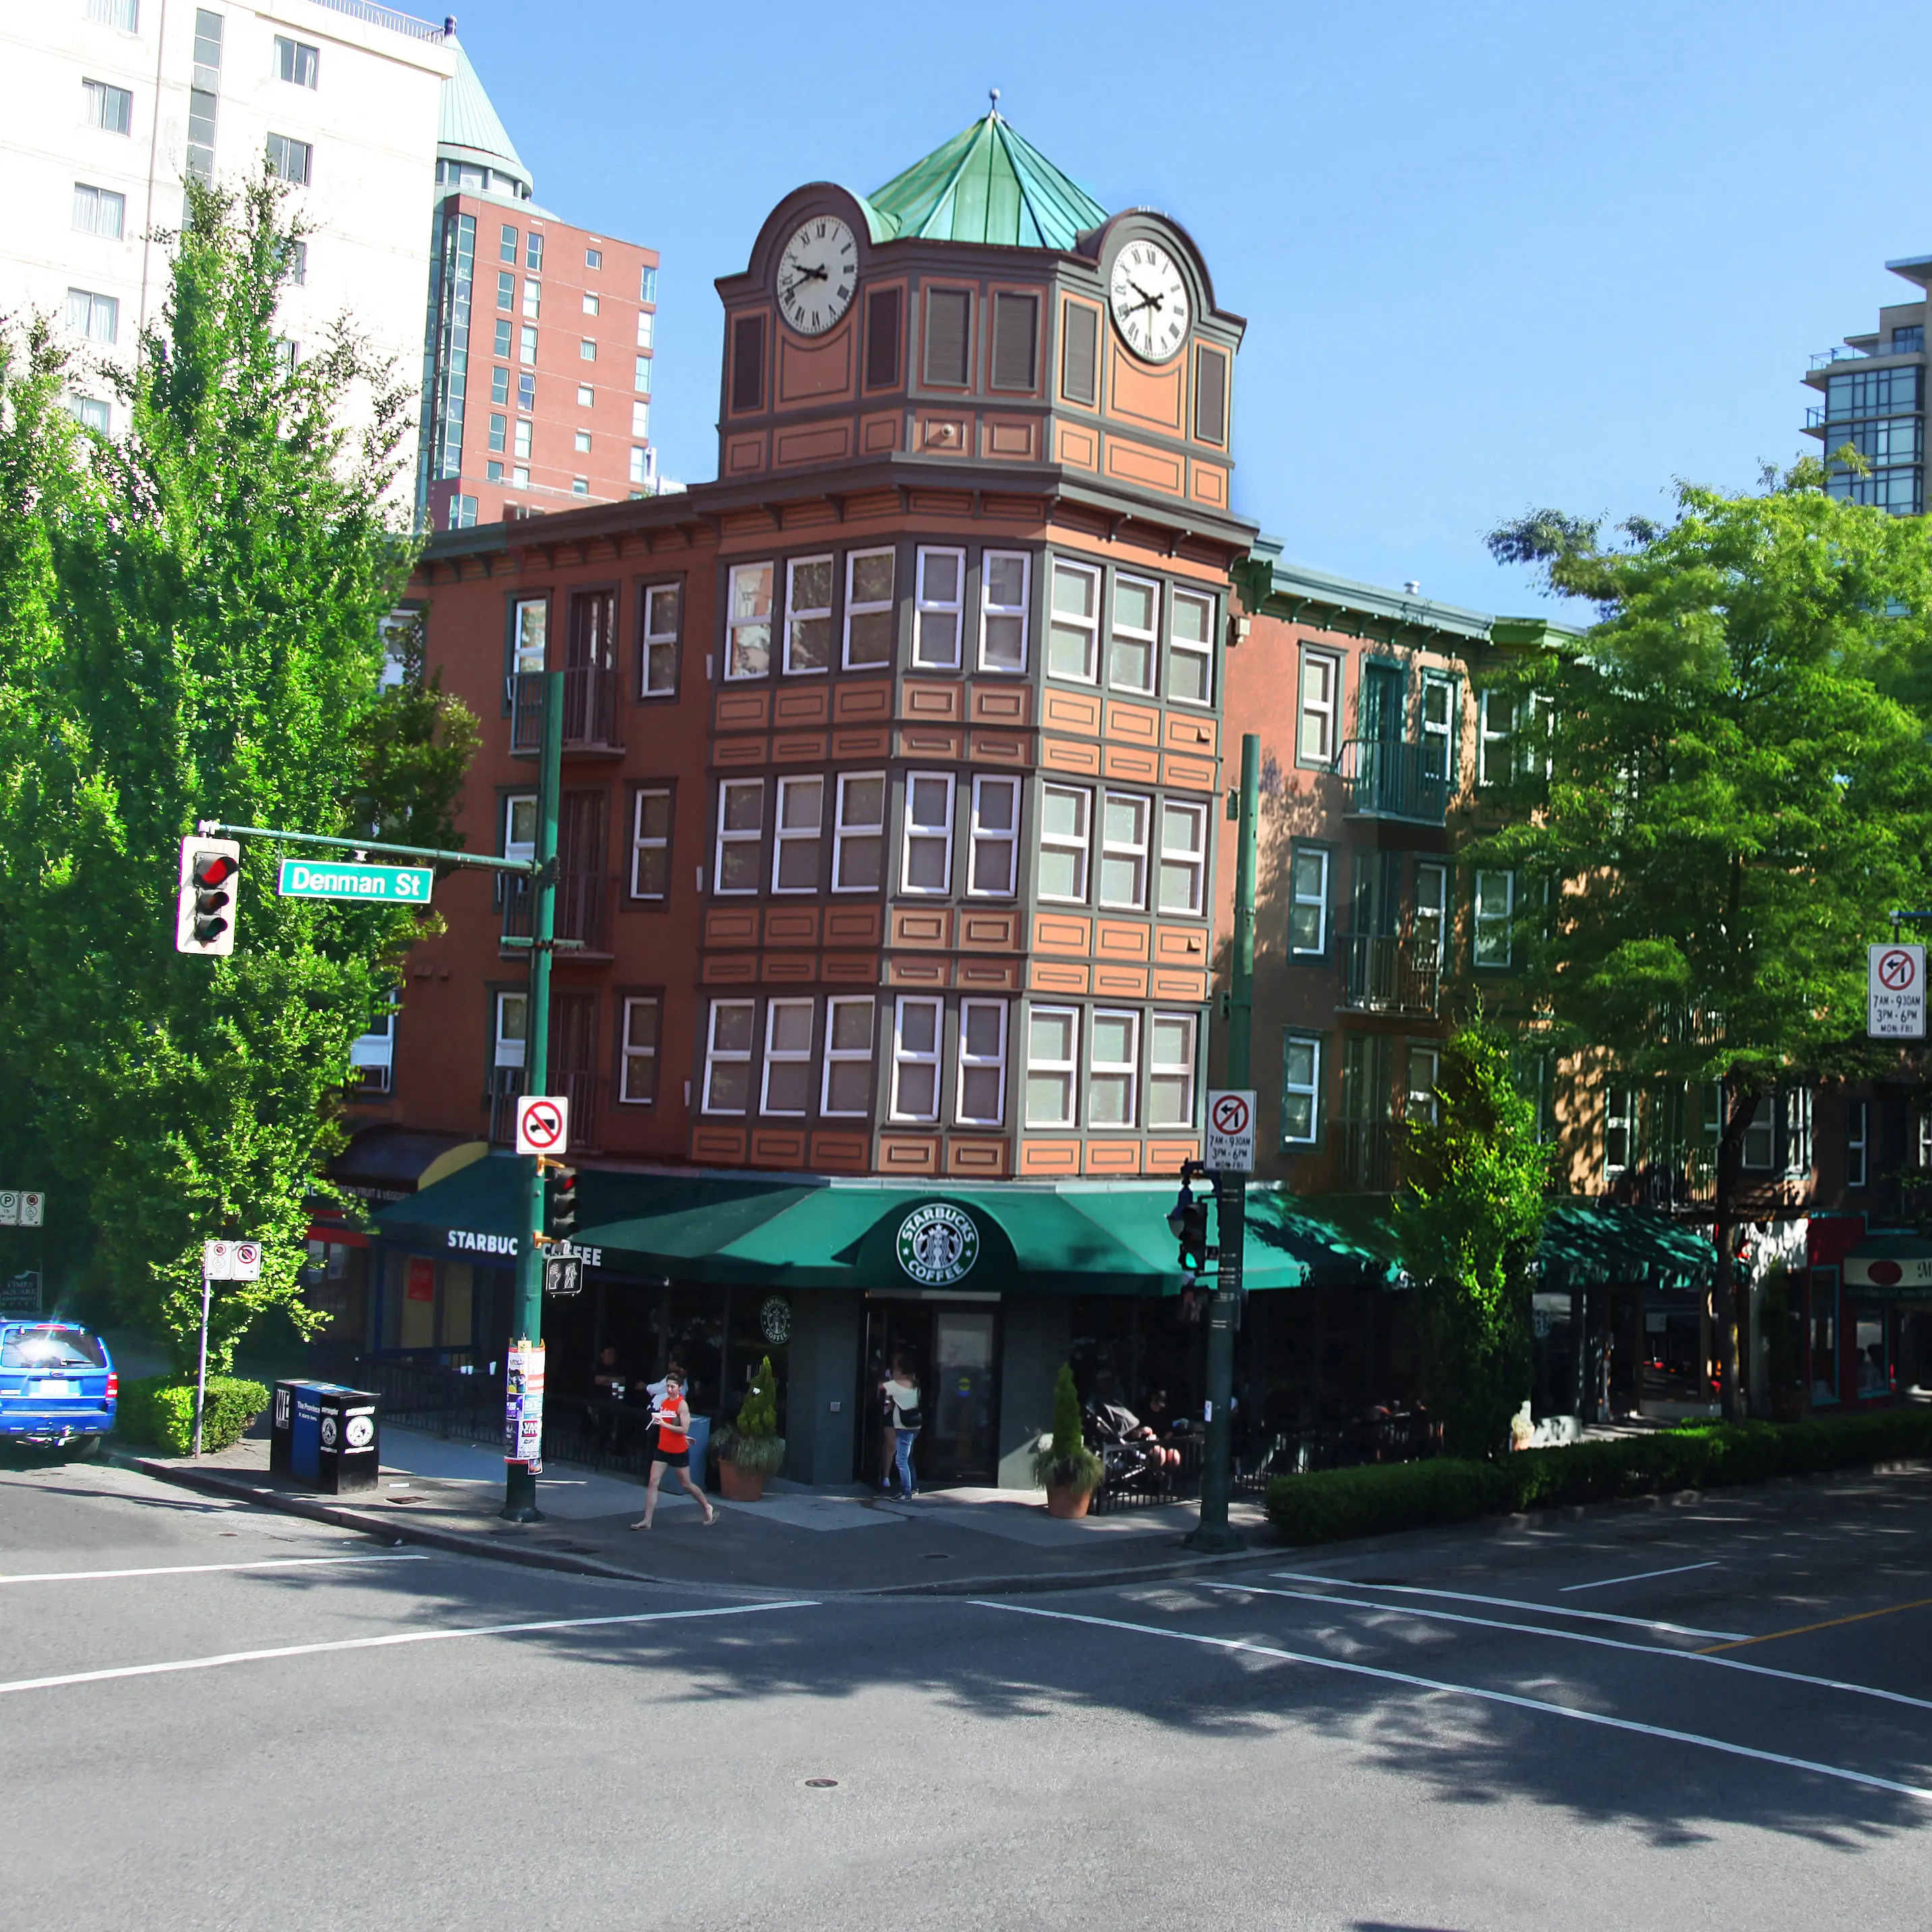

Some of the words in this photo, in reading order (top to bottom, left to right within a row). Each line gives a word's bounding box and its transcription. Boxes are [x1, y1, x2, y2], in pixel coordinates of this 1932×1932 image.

[291, 867, 386, 894] Denman
[395, 873, 420, 896] St
[1874, 995, 1889, 1008] 7AM
[1877, 1009, 1893, 1023] 3PM
[1900, 1010, 1917, 1023] 6PM
[1210, 1135, 1223, 1147] 7AM
[1212, 1147, 1226, 1159] 3PM
[1232, 1149, 1247, 1160] 6PM
[358, 1187, 375, 1197] FRUIT
[902, 1207, 975, 1243] STARBUCKS
[448, 1230, 518, 1255] STARBUC
[542, 1243, 602, 1267] CFEE
[908, 1259, 964, 1282] COFFEE
[762, 1297, 791, 1319] STARBUCKS
[766, 1328, 788, 1341] COFFEE
